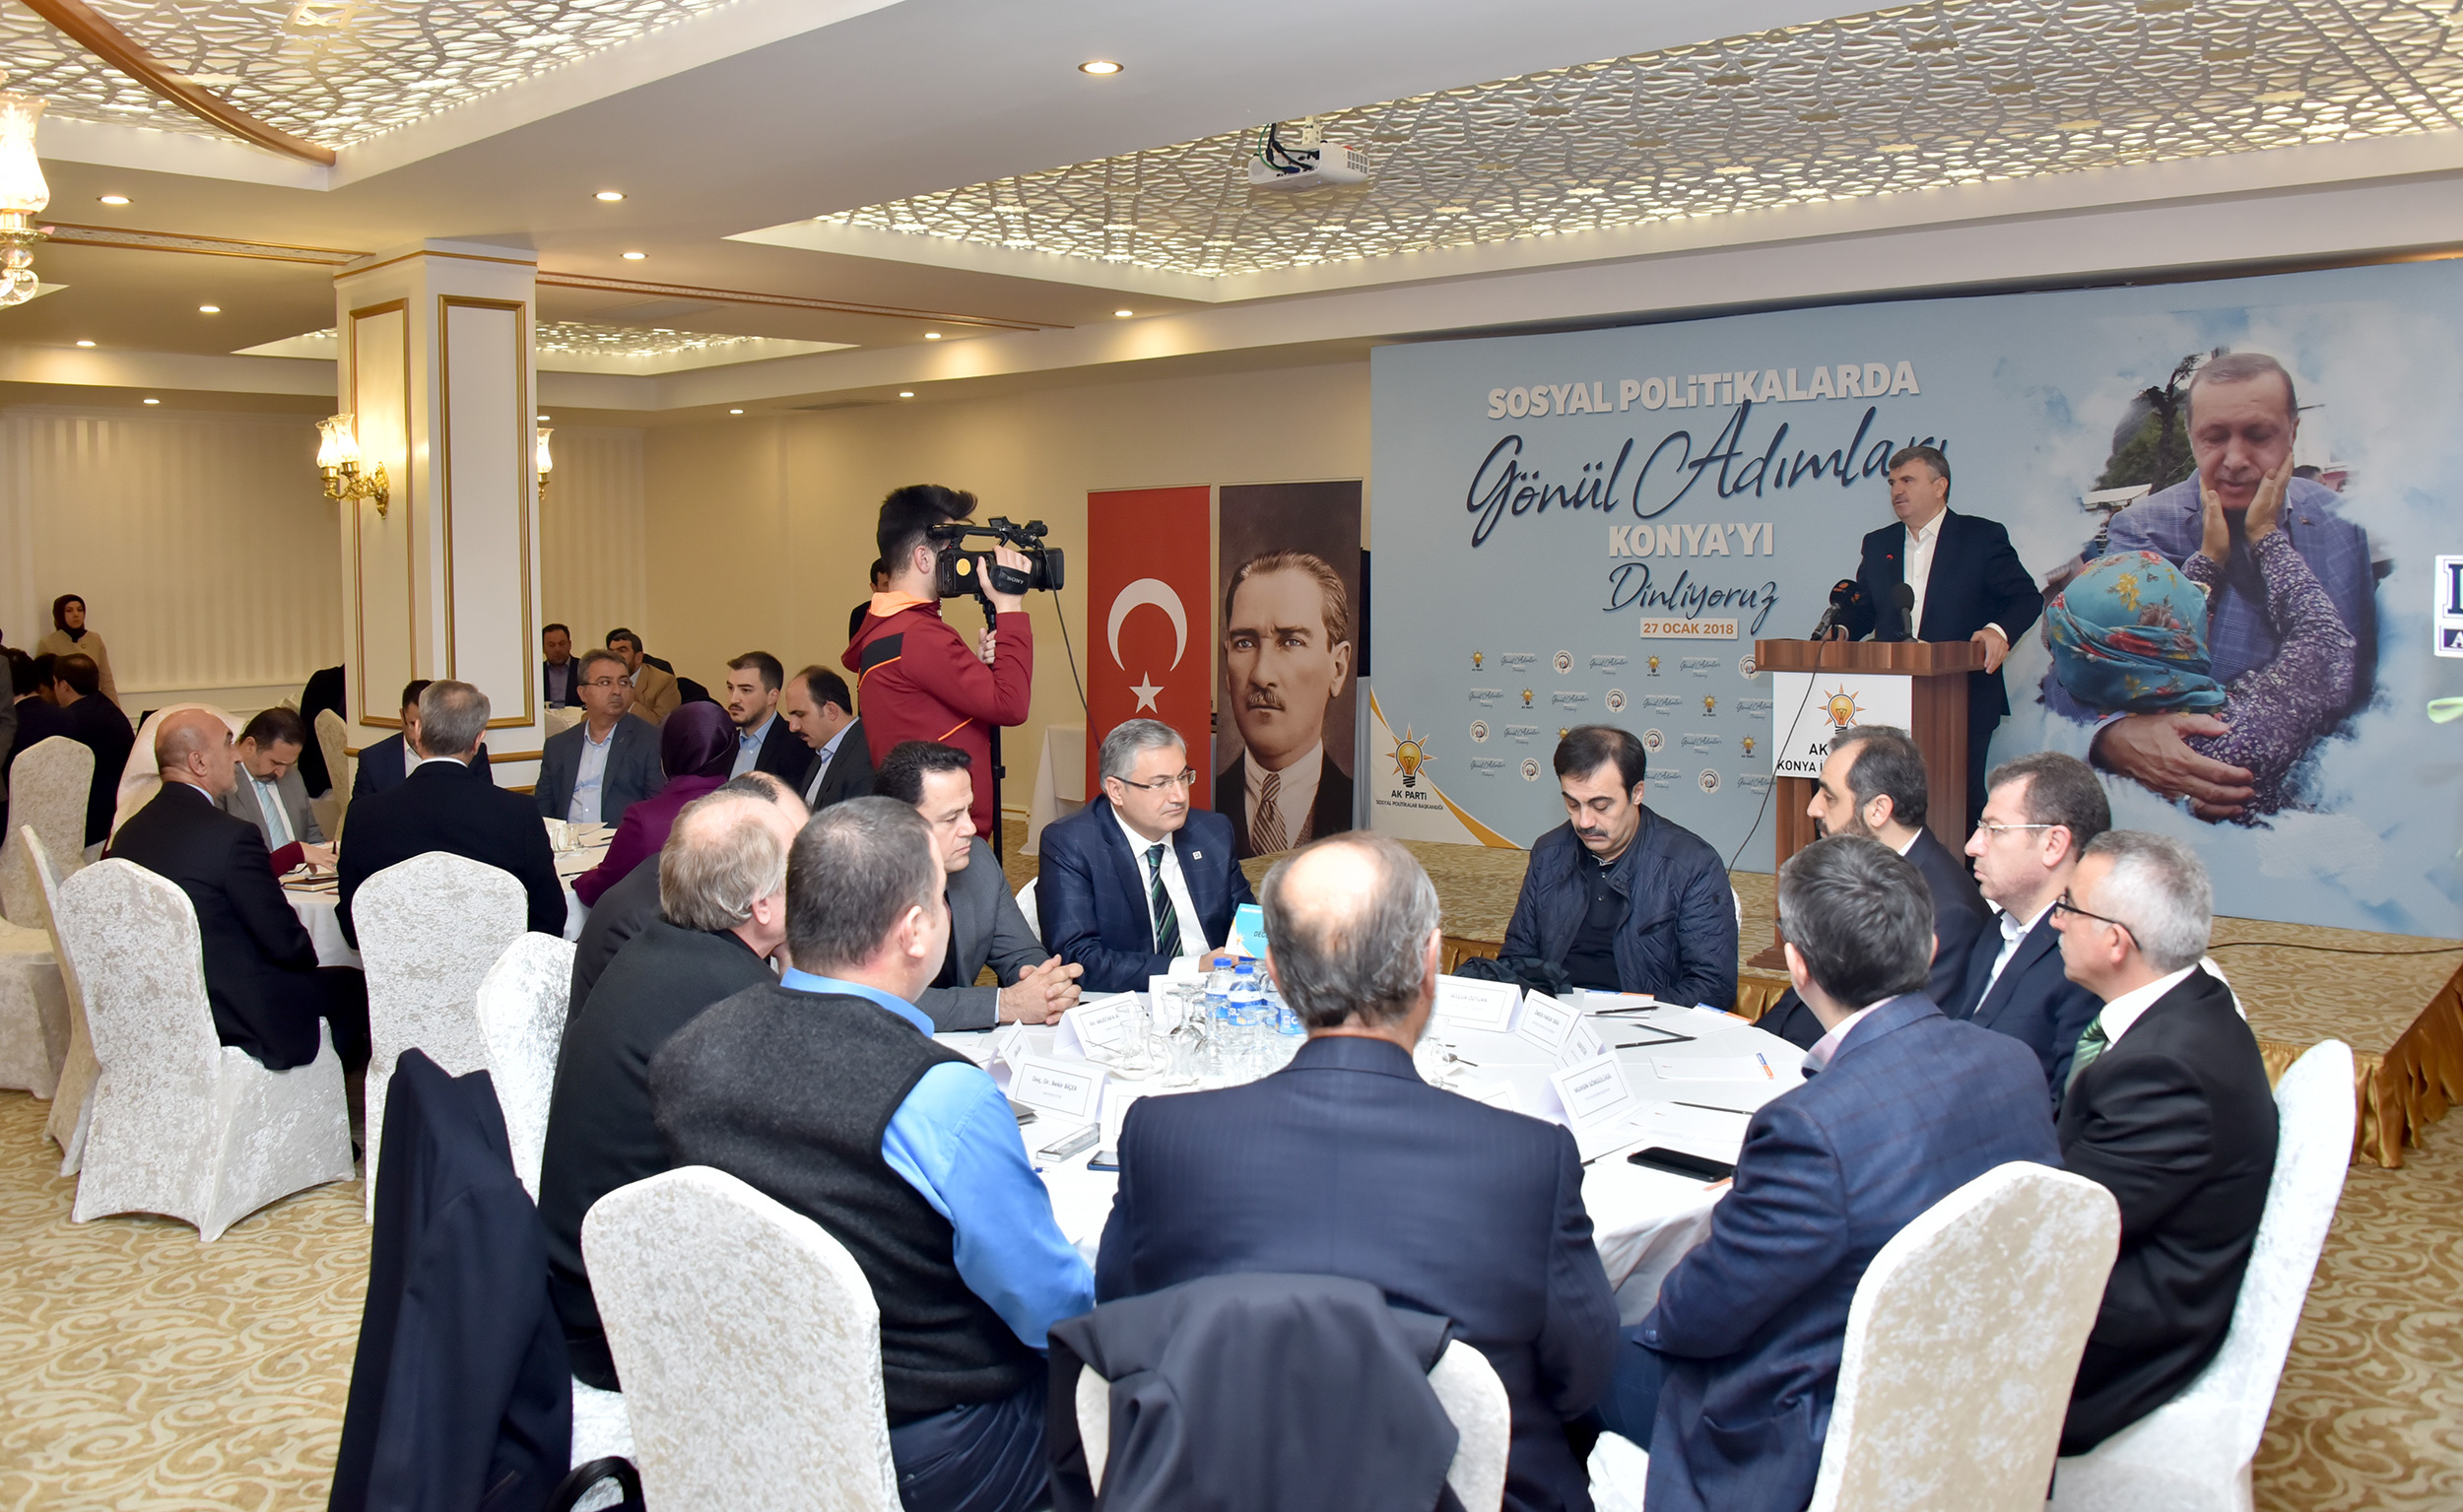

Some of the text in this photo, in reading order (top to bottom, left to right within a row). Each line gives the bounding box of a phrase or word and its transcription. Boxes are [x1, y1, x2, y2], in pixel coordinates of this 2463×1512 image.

[1487, 380, 1614, 420] SOSYAL
[1466, 433, 1634, 549] Gönül
[1609, 523, 1774, 559] KONYA'YI
[1006, 575, 1024, 585] SONY
[1602, 562, 1779, 636] Dinliyoruz
[1642, 623, 1734, 635] 27 OCAK 2018
[1808, 743, 1829, 756] AK
[1776, 759, 1817, 773] KONYA
[1391, 789, 1403, 799] AK
